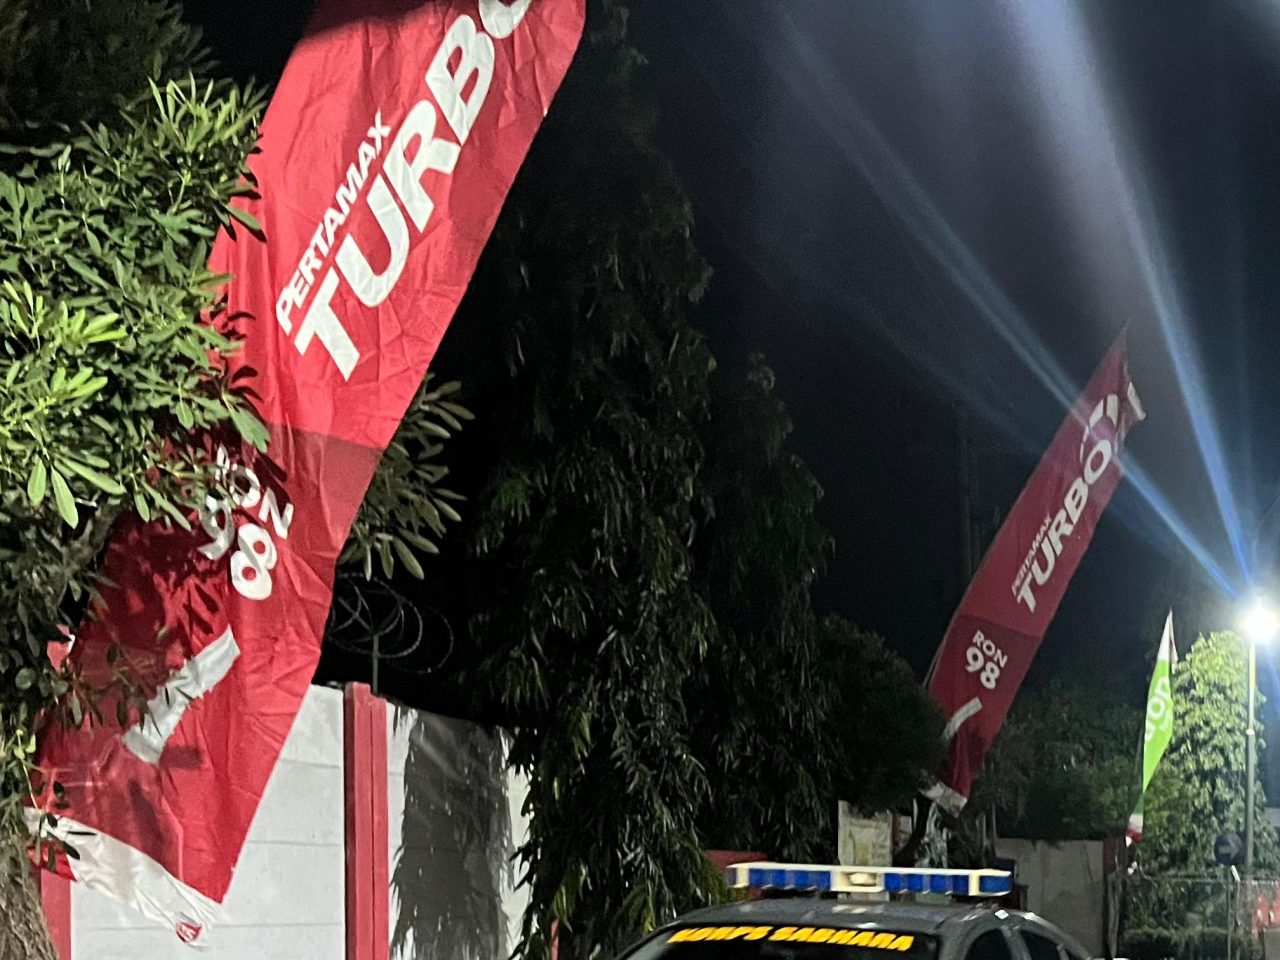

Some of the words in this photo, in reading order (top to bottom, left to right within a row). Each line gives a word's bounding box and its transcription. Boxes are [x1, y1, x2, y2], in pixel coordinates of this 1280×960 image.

[275, 107, 391, 336] PERTAMAX
[198, 495, 278, 600] 98
[1016, 438, 1112, 614] TURBO
[965, 646, 1001, 690] 98
[973, 630, 1008, 668] RON
